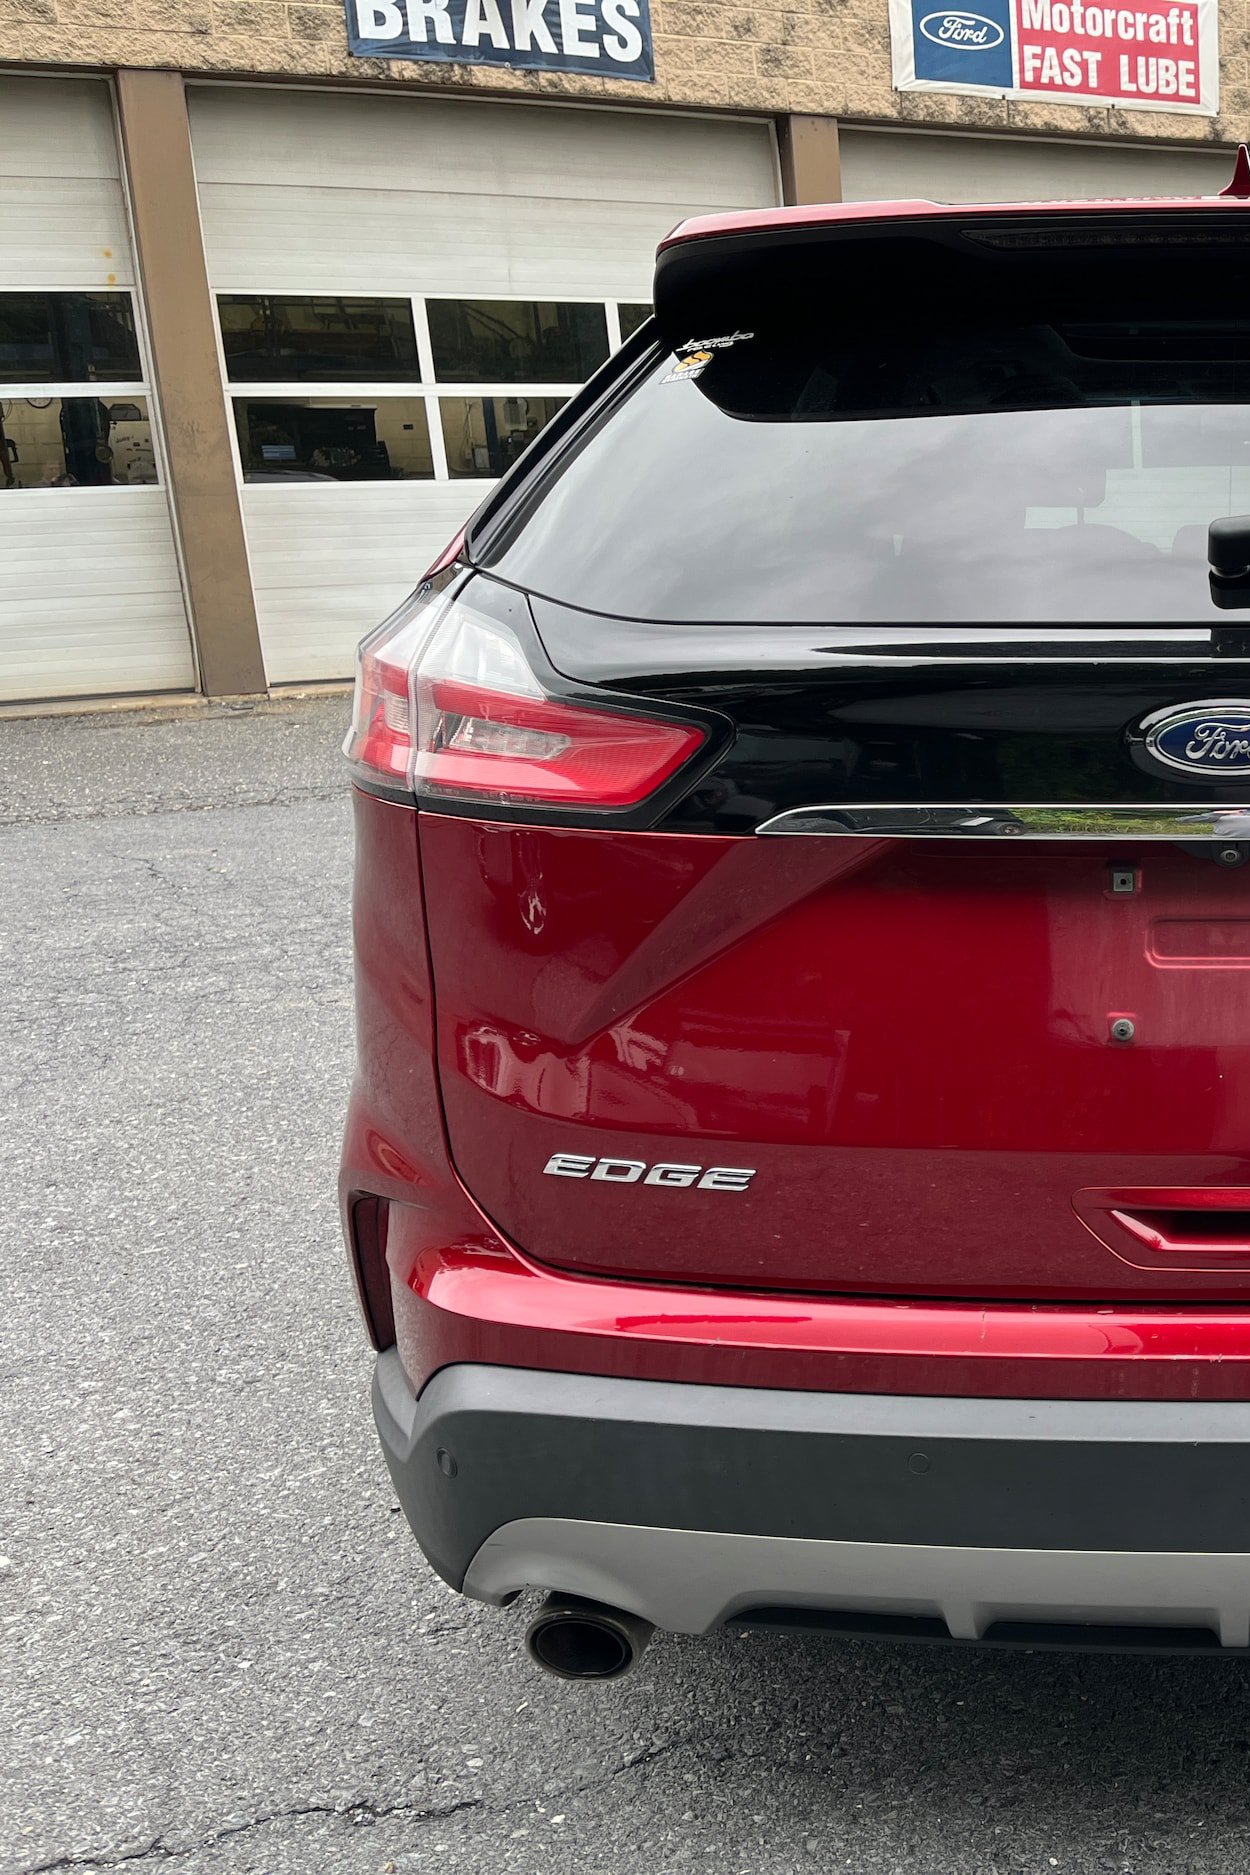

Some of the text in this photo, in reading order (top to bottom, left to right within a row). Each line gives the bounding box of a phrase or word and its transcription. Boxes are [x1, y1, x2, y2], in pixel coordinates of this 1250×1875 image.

[356, 0, 643, 63] BRAKES
[939, 15, 987, 45] Ford
[1021, 0, 1194, 46] Motorcraft
[1022, 45, 1196, 97] FAST LUBE
[542, 1152, 757, 1192] EDGE
